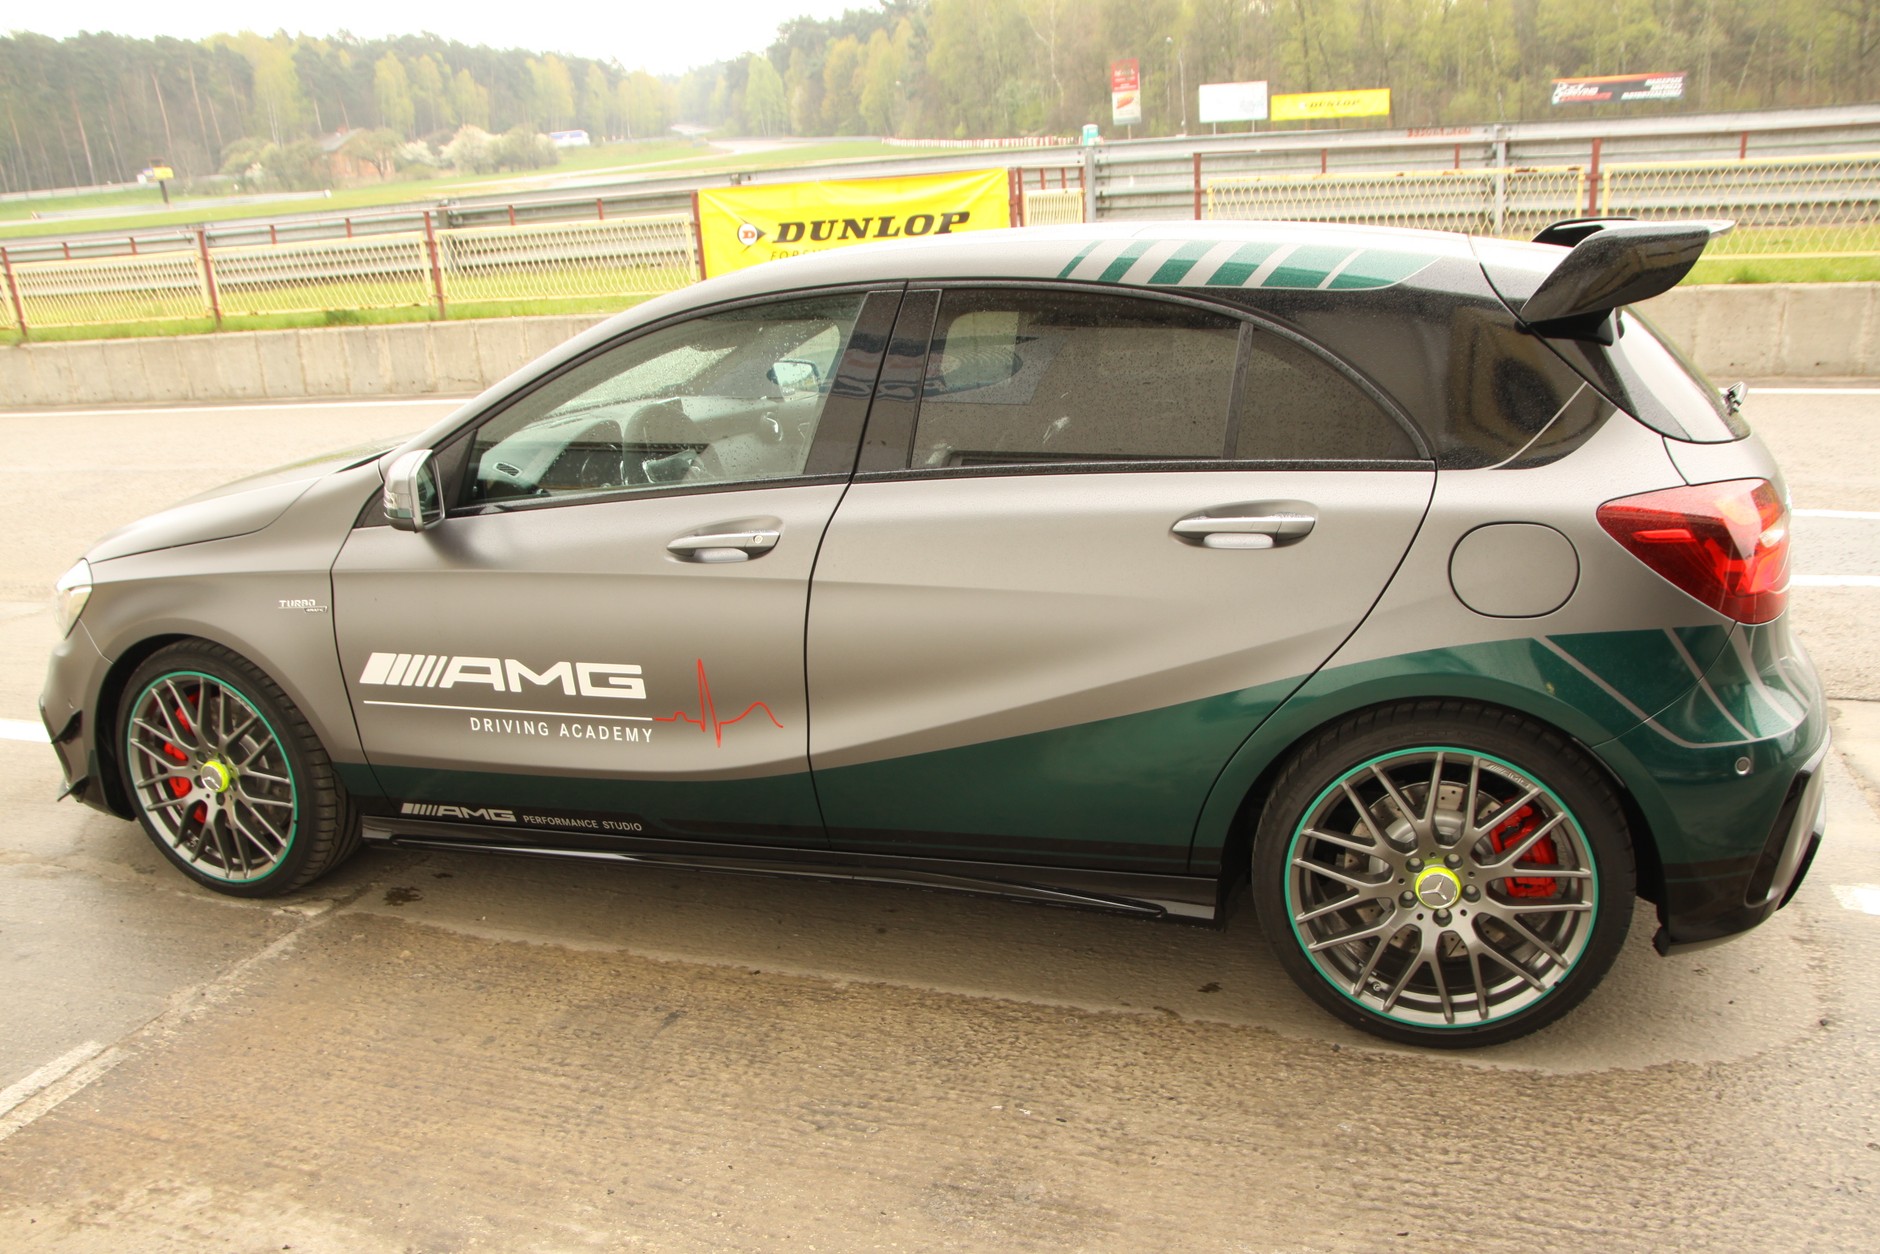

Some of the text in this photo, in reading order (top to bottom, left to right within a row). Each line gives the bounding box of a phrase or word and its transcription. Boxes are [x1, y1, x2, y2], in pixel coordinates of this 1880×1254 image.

[772, 211, 970, 244] DUNLOP
[279, 599, 316, 608] TURBO
[439, 656, 647, 699] AMG
[469, 717, 653, 743] DRIVING ACADEMY
[437, 805, 642, 832] AMG PERFORMANCE STUDIO
